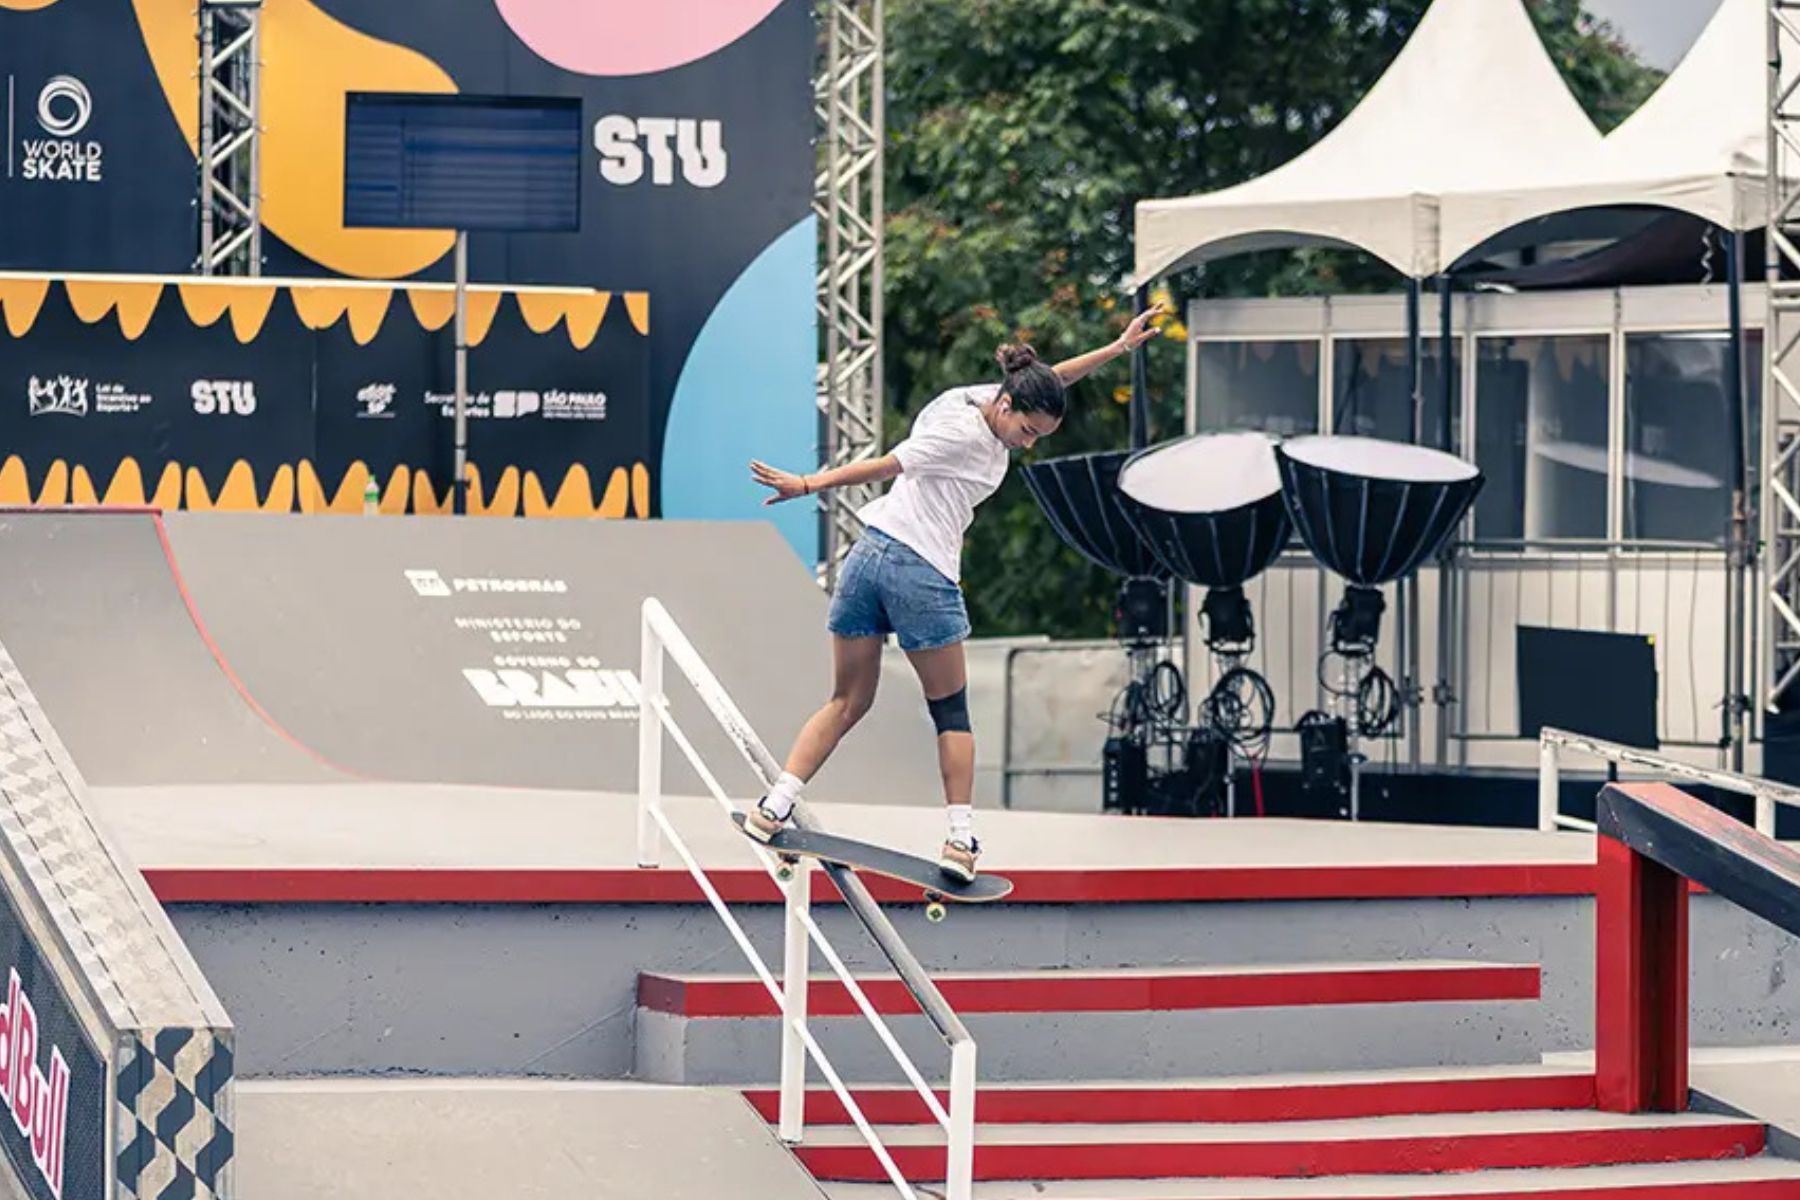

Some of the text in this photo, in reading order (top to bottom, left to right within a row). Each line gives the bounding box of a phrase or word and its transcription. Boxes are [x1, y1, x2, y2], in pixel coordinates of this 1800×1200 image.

[23, 140, 102, 160] WORLD
[593, 114, 727, 188] STU
[23, 158, 102, 181] SKATE
[191, 379, 257, 416] STU
[453, 578, 568, 593] PETROBRAS
